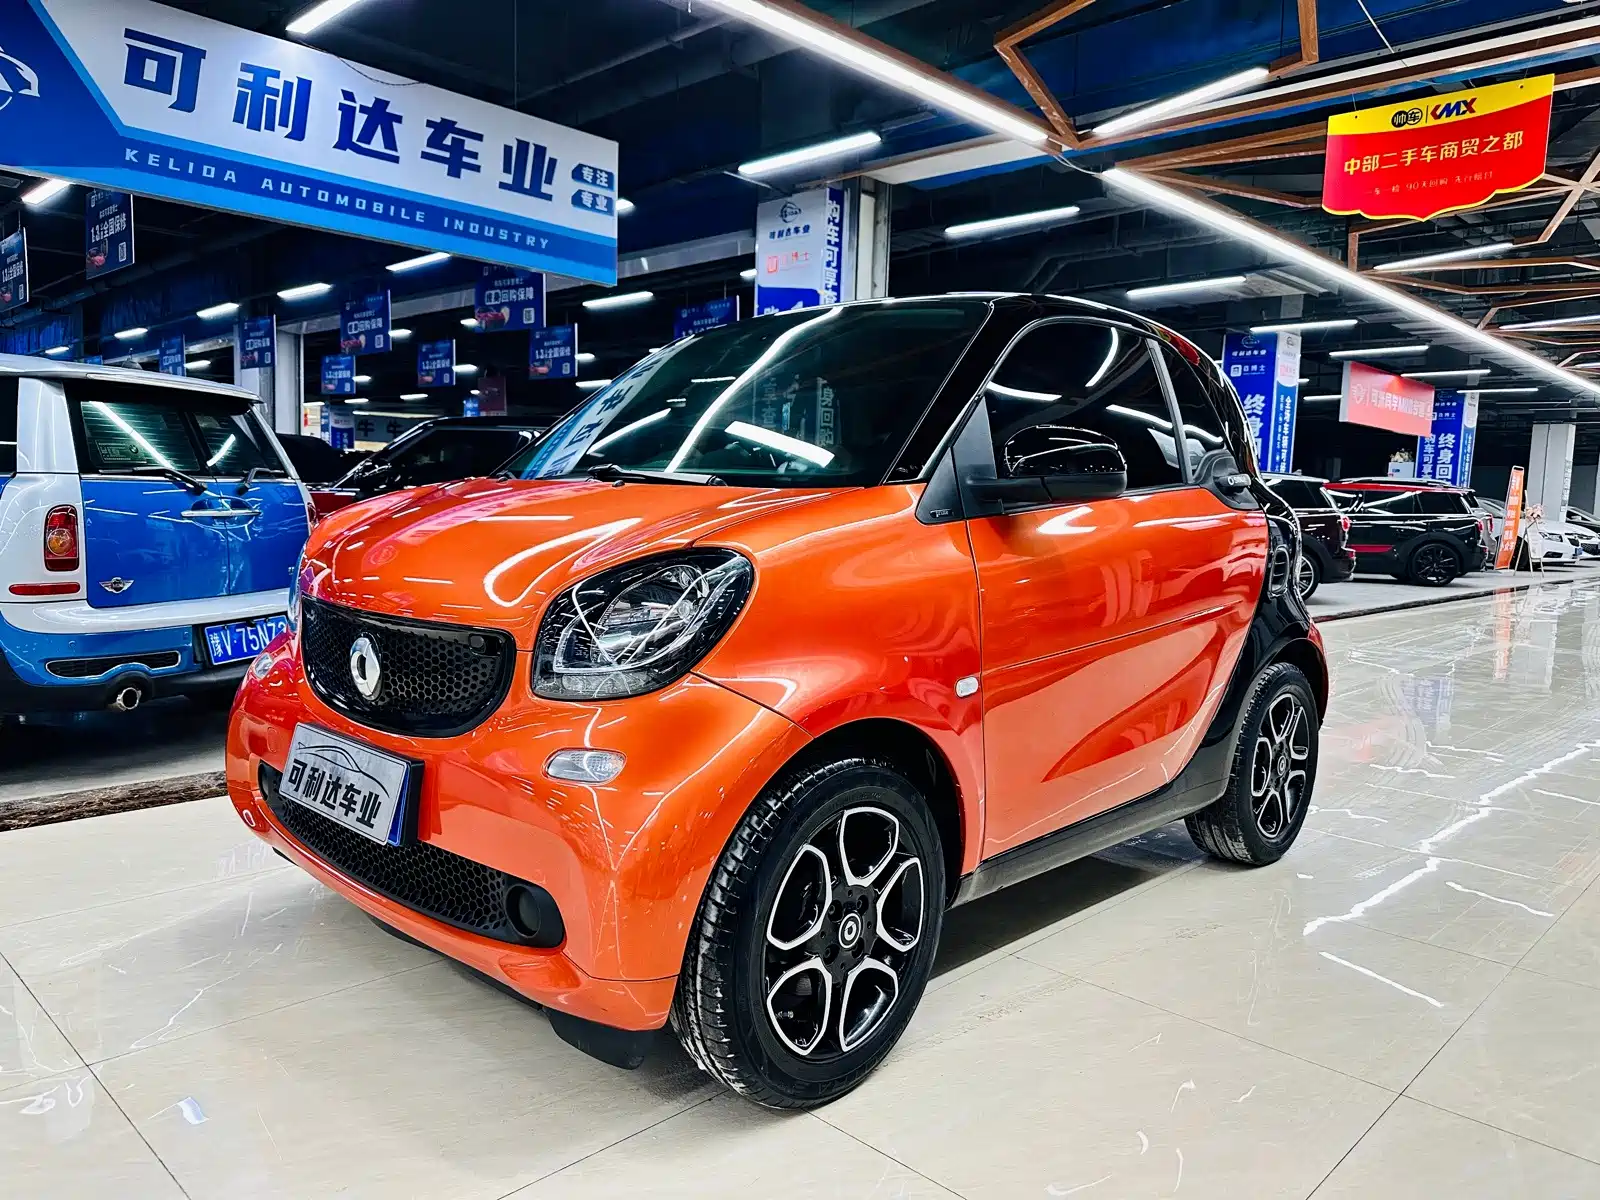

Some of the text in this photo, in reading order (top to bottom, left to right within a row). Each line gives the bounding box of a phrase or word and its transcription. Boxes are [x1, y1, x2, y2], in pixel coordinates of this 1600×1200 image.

[123, 28, 559, 203] 可利达车业
[581, 166, 609, 188] 专注
[1343, 130, 1524, 176] 中部二手车商贸之都
[125, 147, 552, 250] KELIDA AUTOMOBILE INDUSTRY
[581, 191, 608, 212] 专业
[1435, 432, 1456, 485] 终身回
[288, 758, 382, 830] 可利达车业
